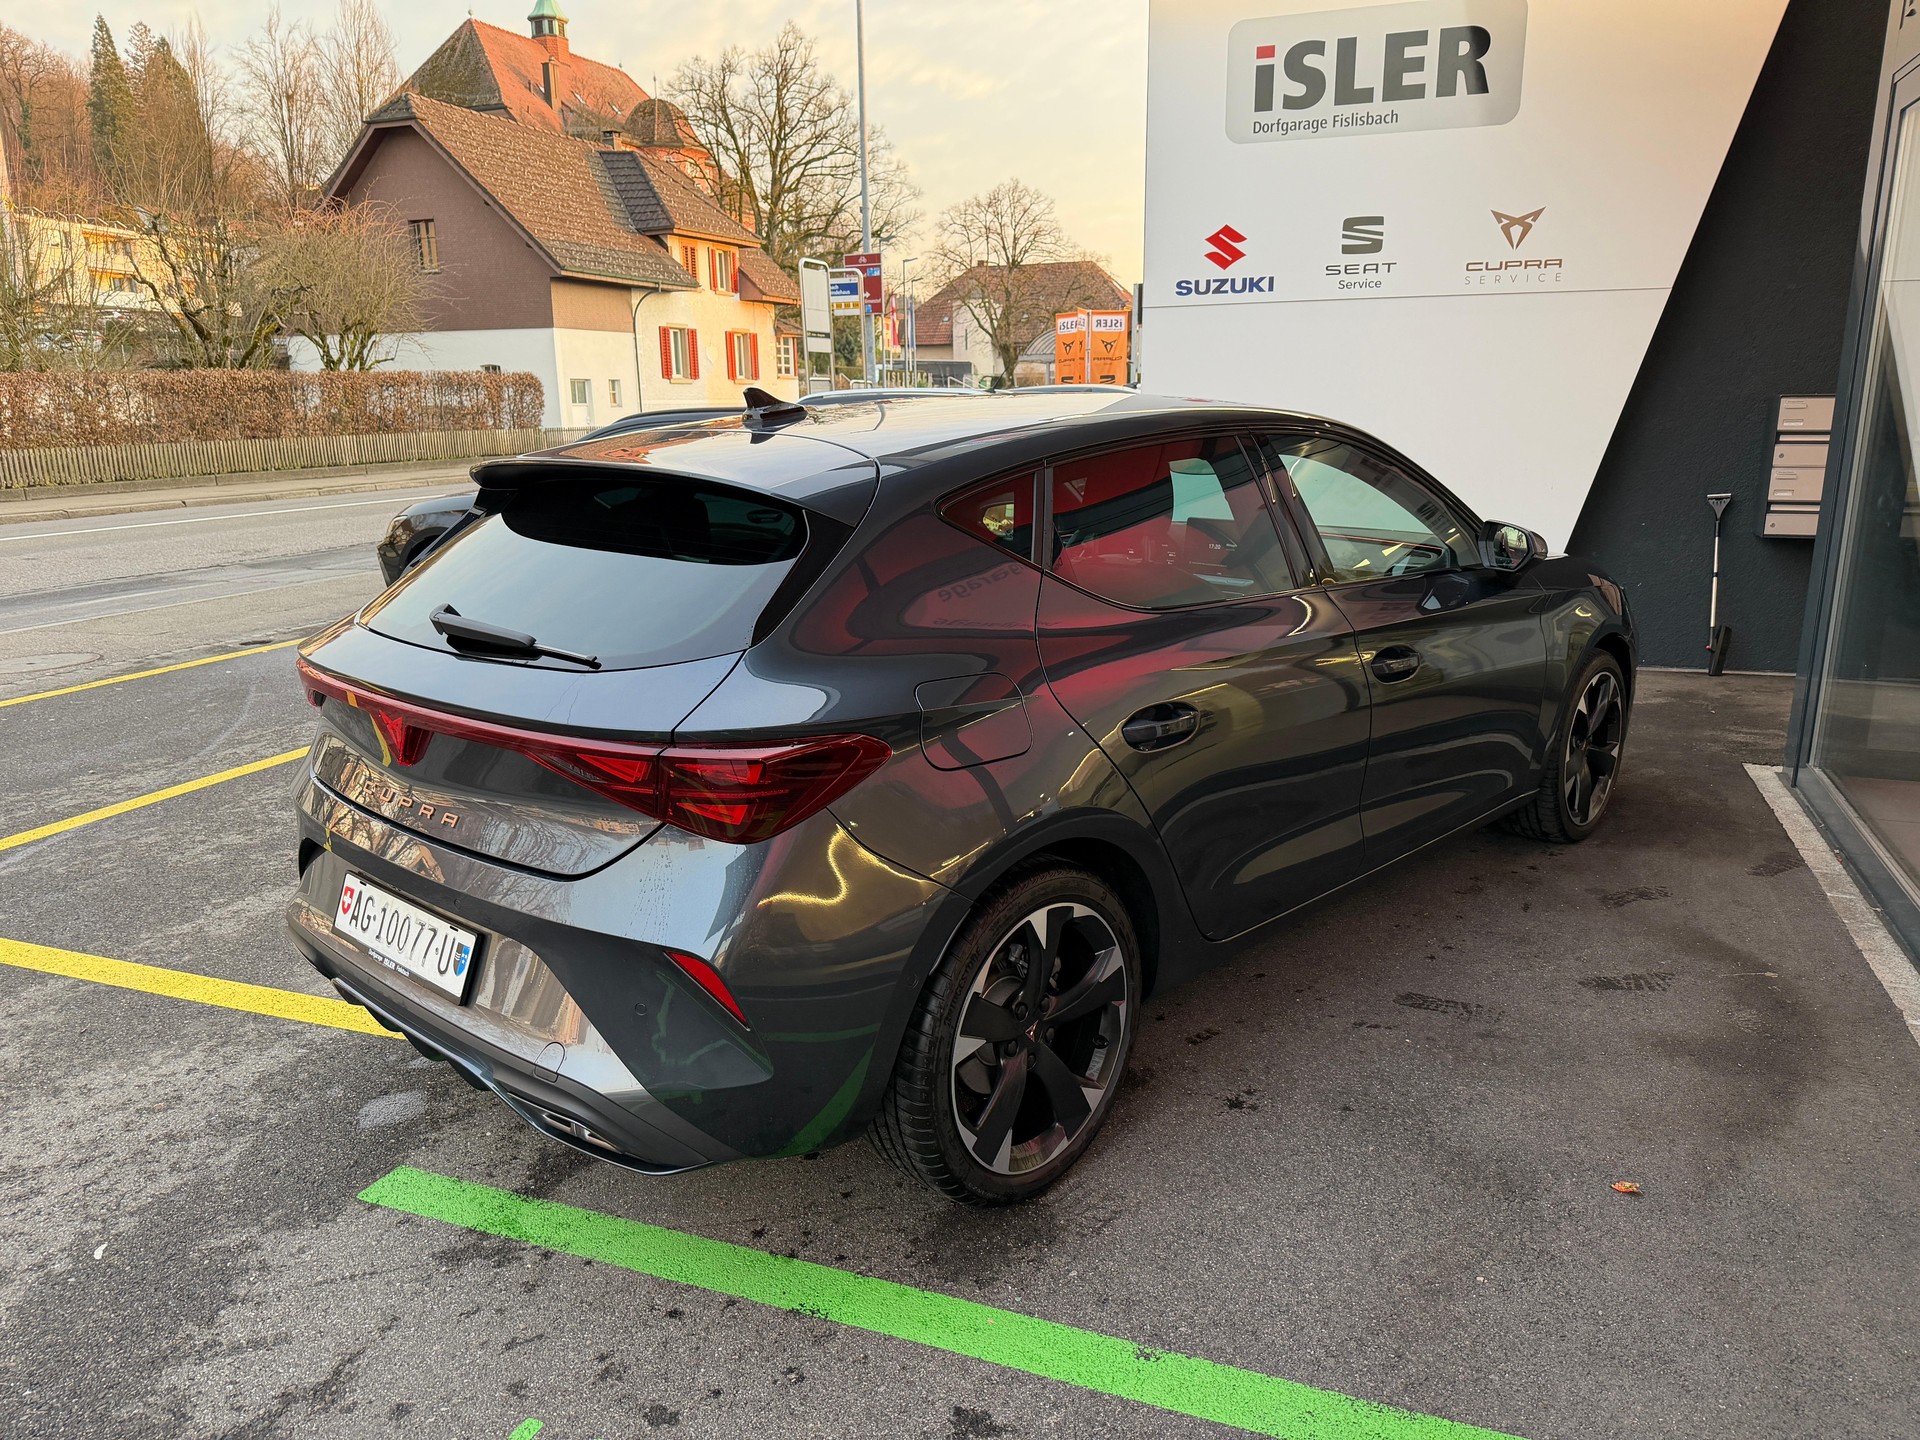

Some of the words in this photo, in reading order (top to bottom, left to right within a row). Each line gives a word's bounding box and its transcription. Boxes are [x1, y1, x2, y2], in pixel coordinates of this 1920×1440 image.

[1253, 24, 1492, 113] iSLER
[1252, 116, 1328, 136] Dorfgarage
[1332, 109, 1399, 129] Fislisbach
[1325, 262, 1397, 276] SEAT
[1465, 258, 1563, 272] CUPRA
[1175, 276, 1275, 297] SUZUKI
[1338, 278, 1382, 290] Service
[1465, 272, 1563, 286] SERVICE
[363, 780, 461, 828] CUPRA
